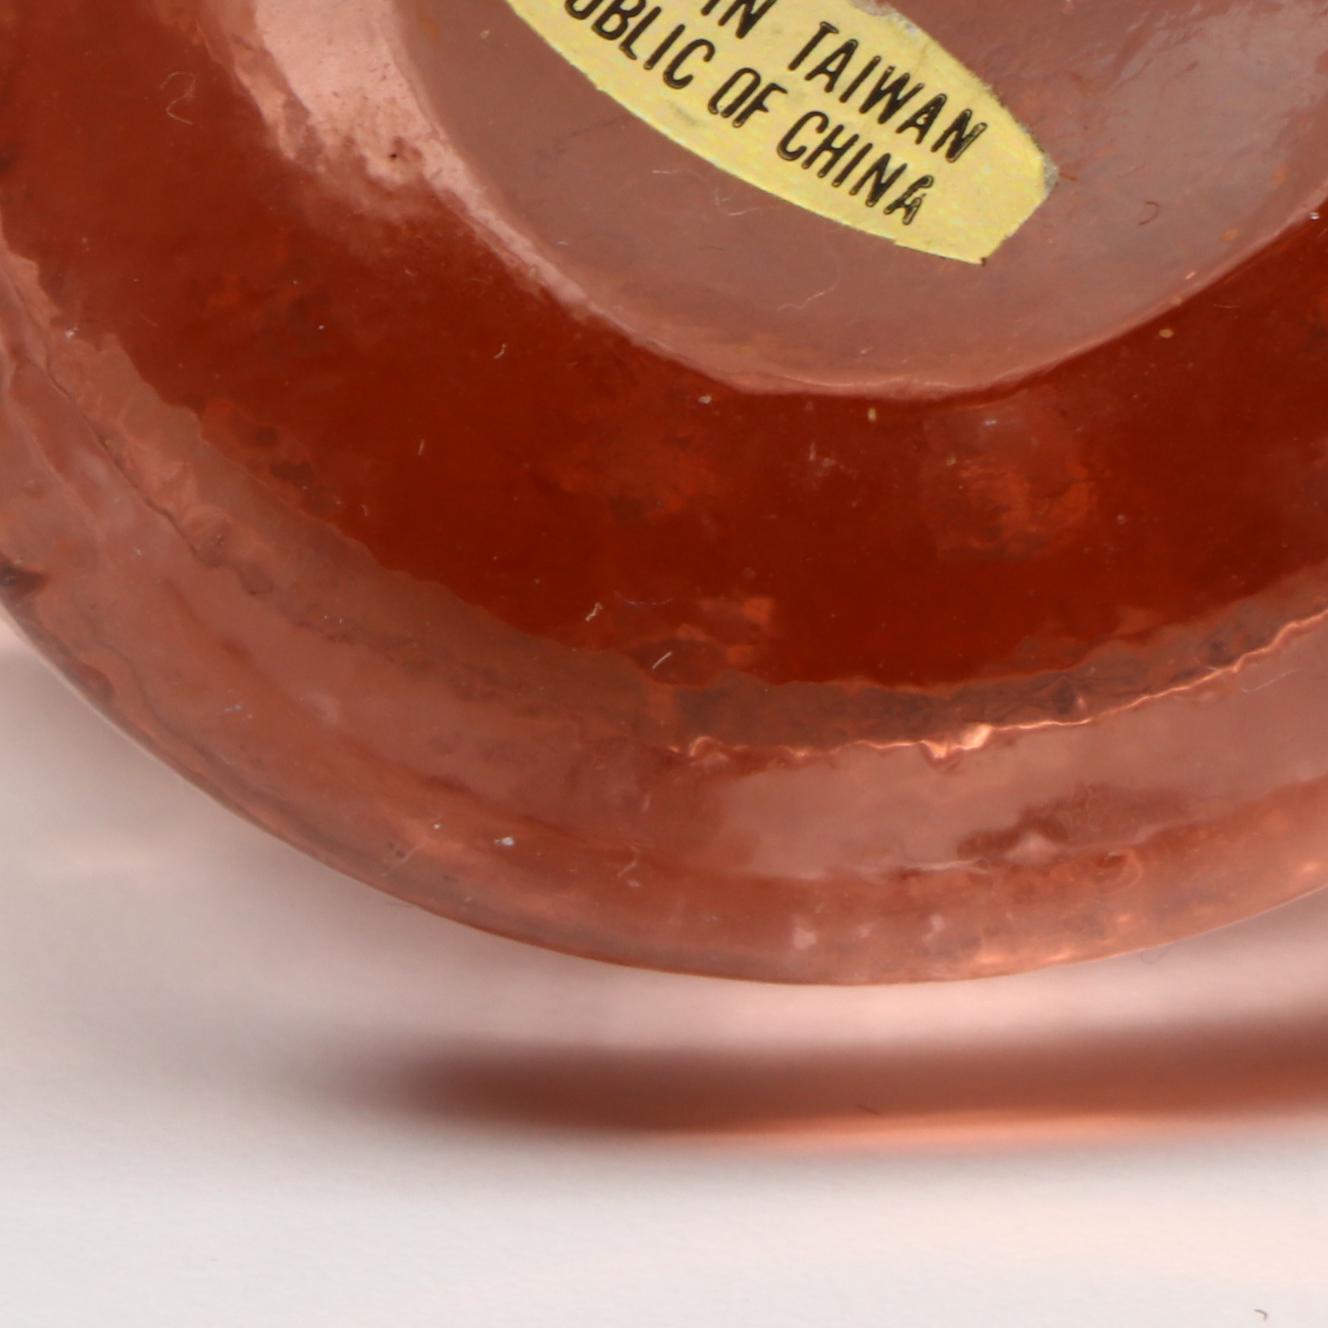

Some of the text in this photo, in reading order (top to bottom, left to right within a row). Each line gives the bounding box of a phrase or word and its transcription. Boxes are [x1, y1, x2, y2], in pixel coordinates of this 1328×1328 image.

[707, 67, 788, 129] OF
[776, 110, 935, 226] CHINA
[787, 20, 988, 164] TAIWAN
